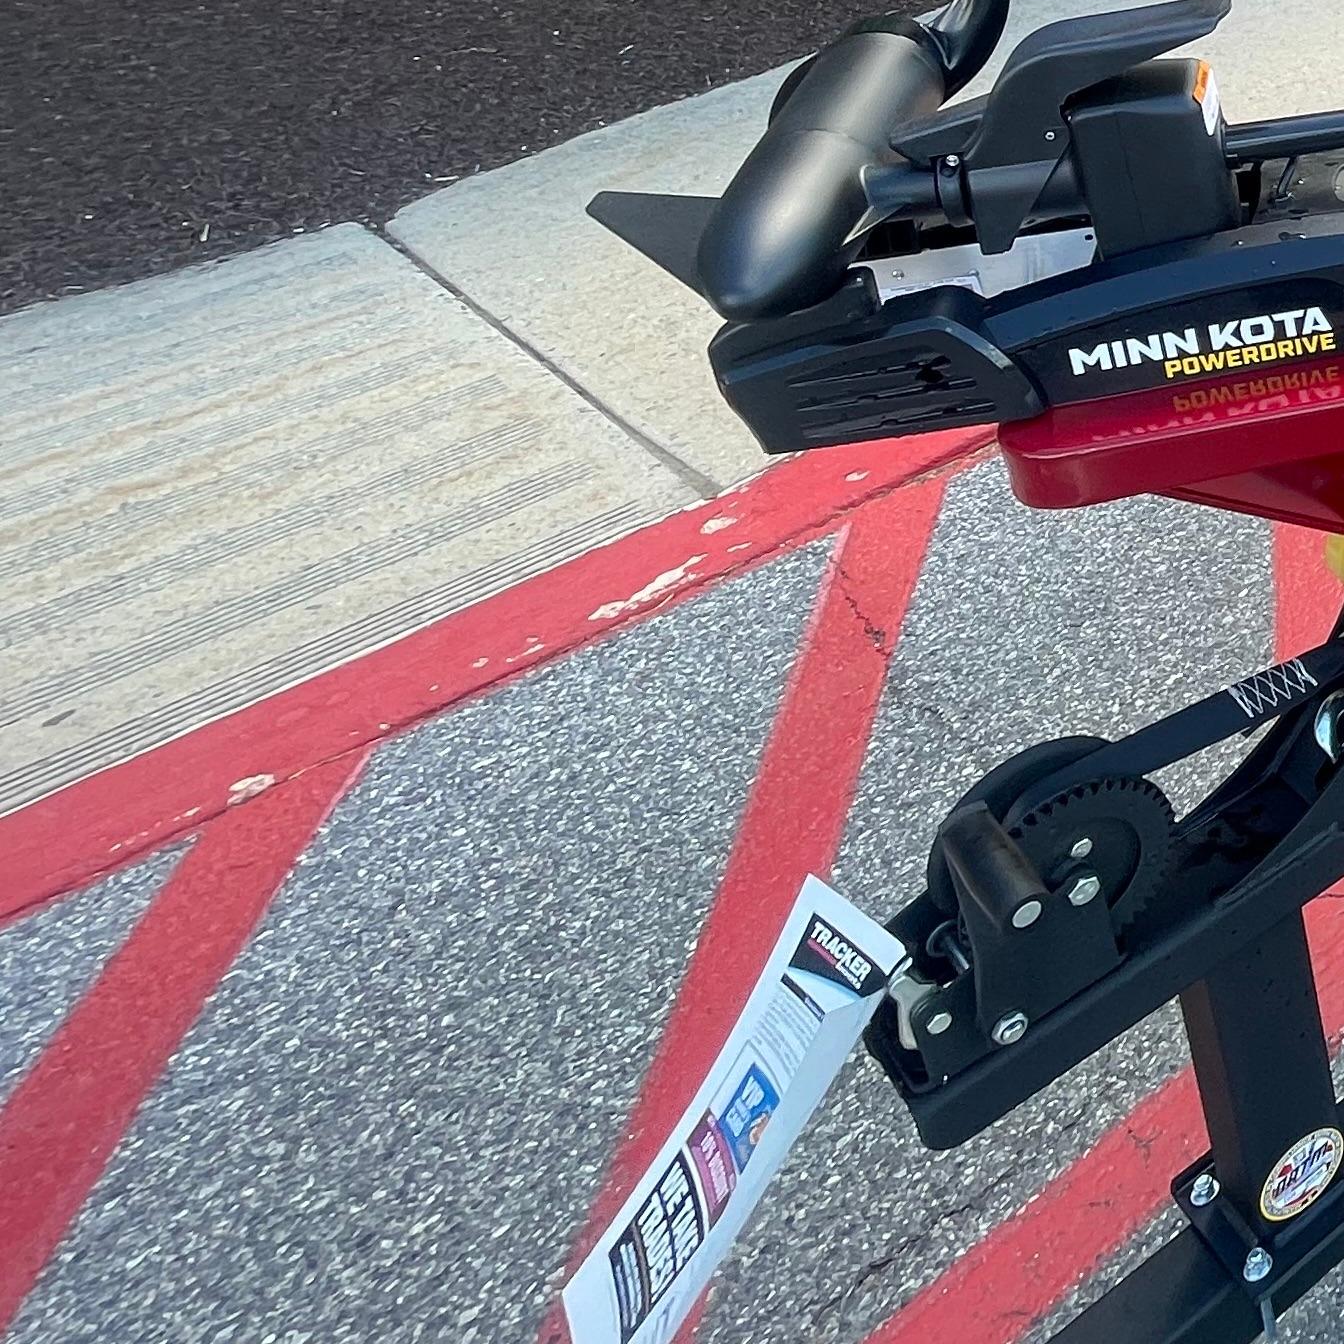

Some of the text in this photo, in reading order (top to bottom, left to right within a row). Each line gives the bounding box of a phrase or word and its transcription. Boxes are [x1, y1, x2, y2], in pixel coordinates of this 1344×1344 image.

[1067, 306, 1333, 376] MINN KOTA
[1164, 332, 1337, 379] POWERDRIVE
[810, 921, 873, 983] TRACKER
